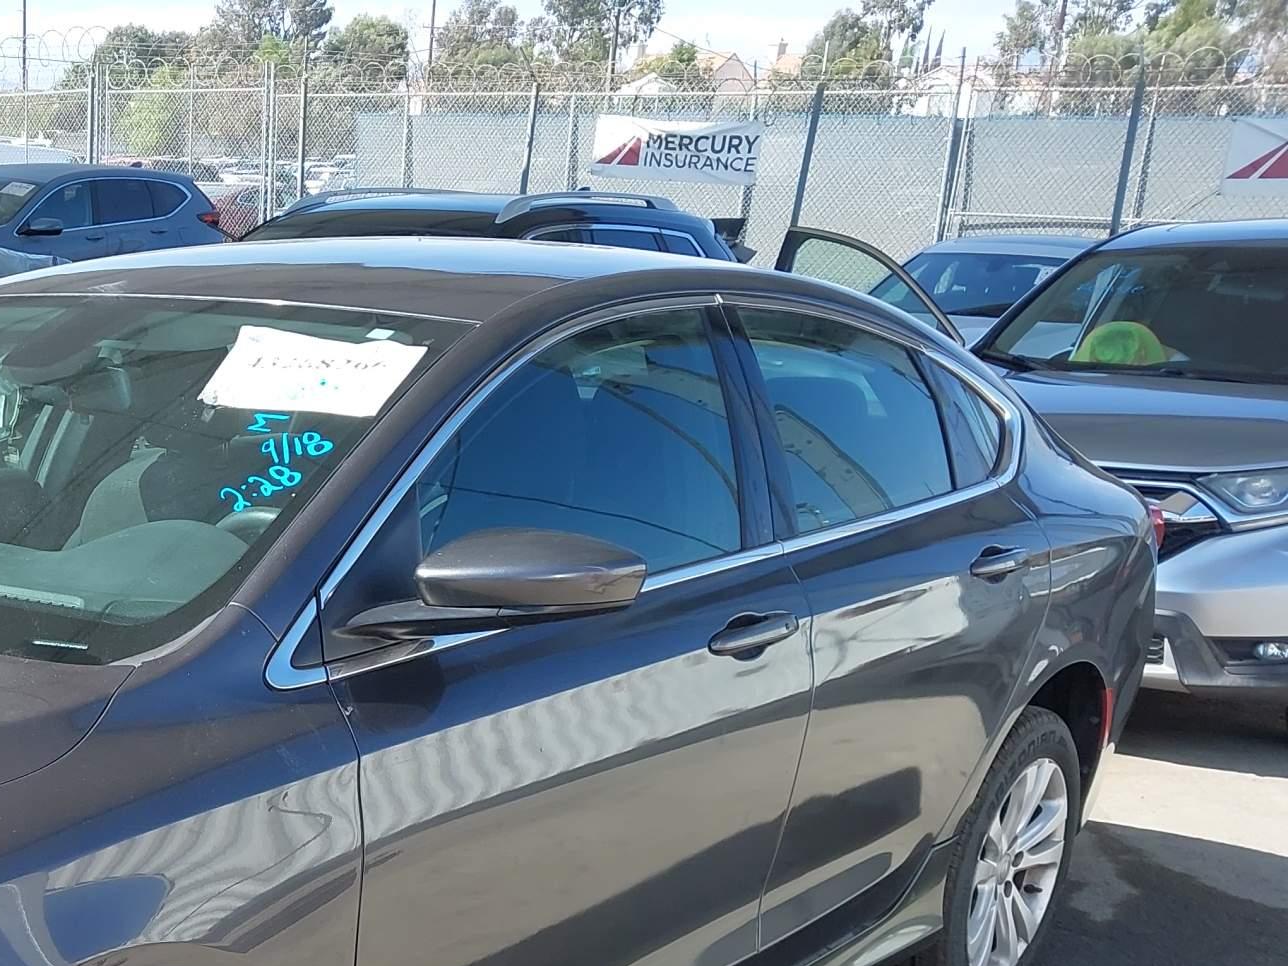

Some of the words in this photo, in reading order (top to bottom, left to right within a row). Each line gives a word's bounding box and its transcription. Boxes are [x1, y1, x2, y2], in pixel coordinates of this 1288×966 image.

[645, 132, 760, 155] MERCURY
[643, 151, 757, 173] INSURANCE
[261, 431, 334, 465] 9/18
[219, 465, 302, 513] 2:28
